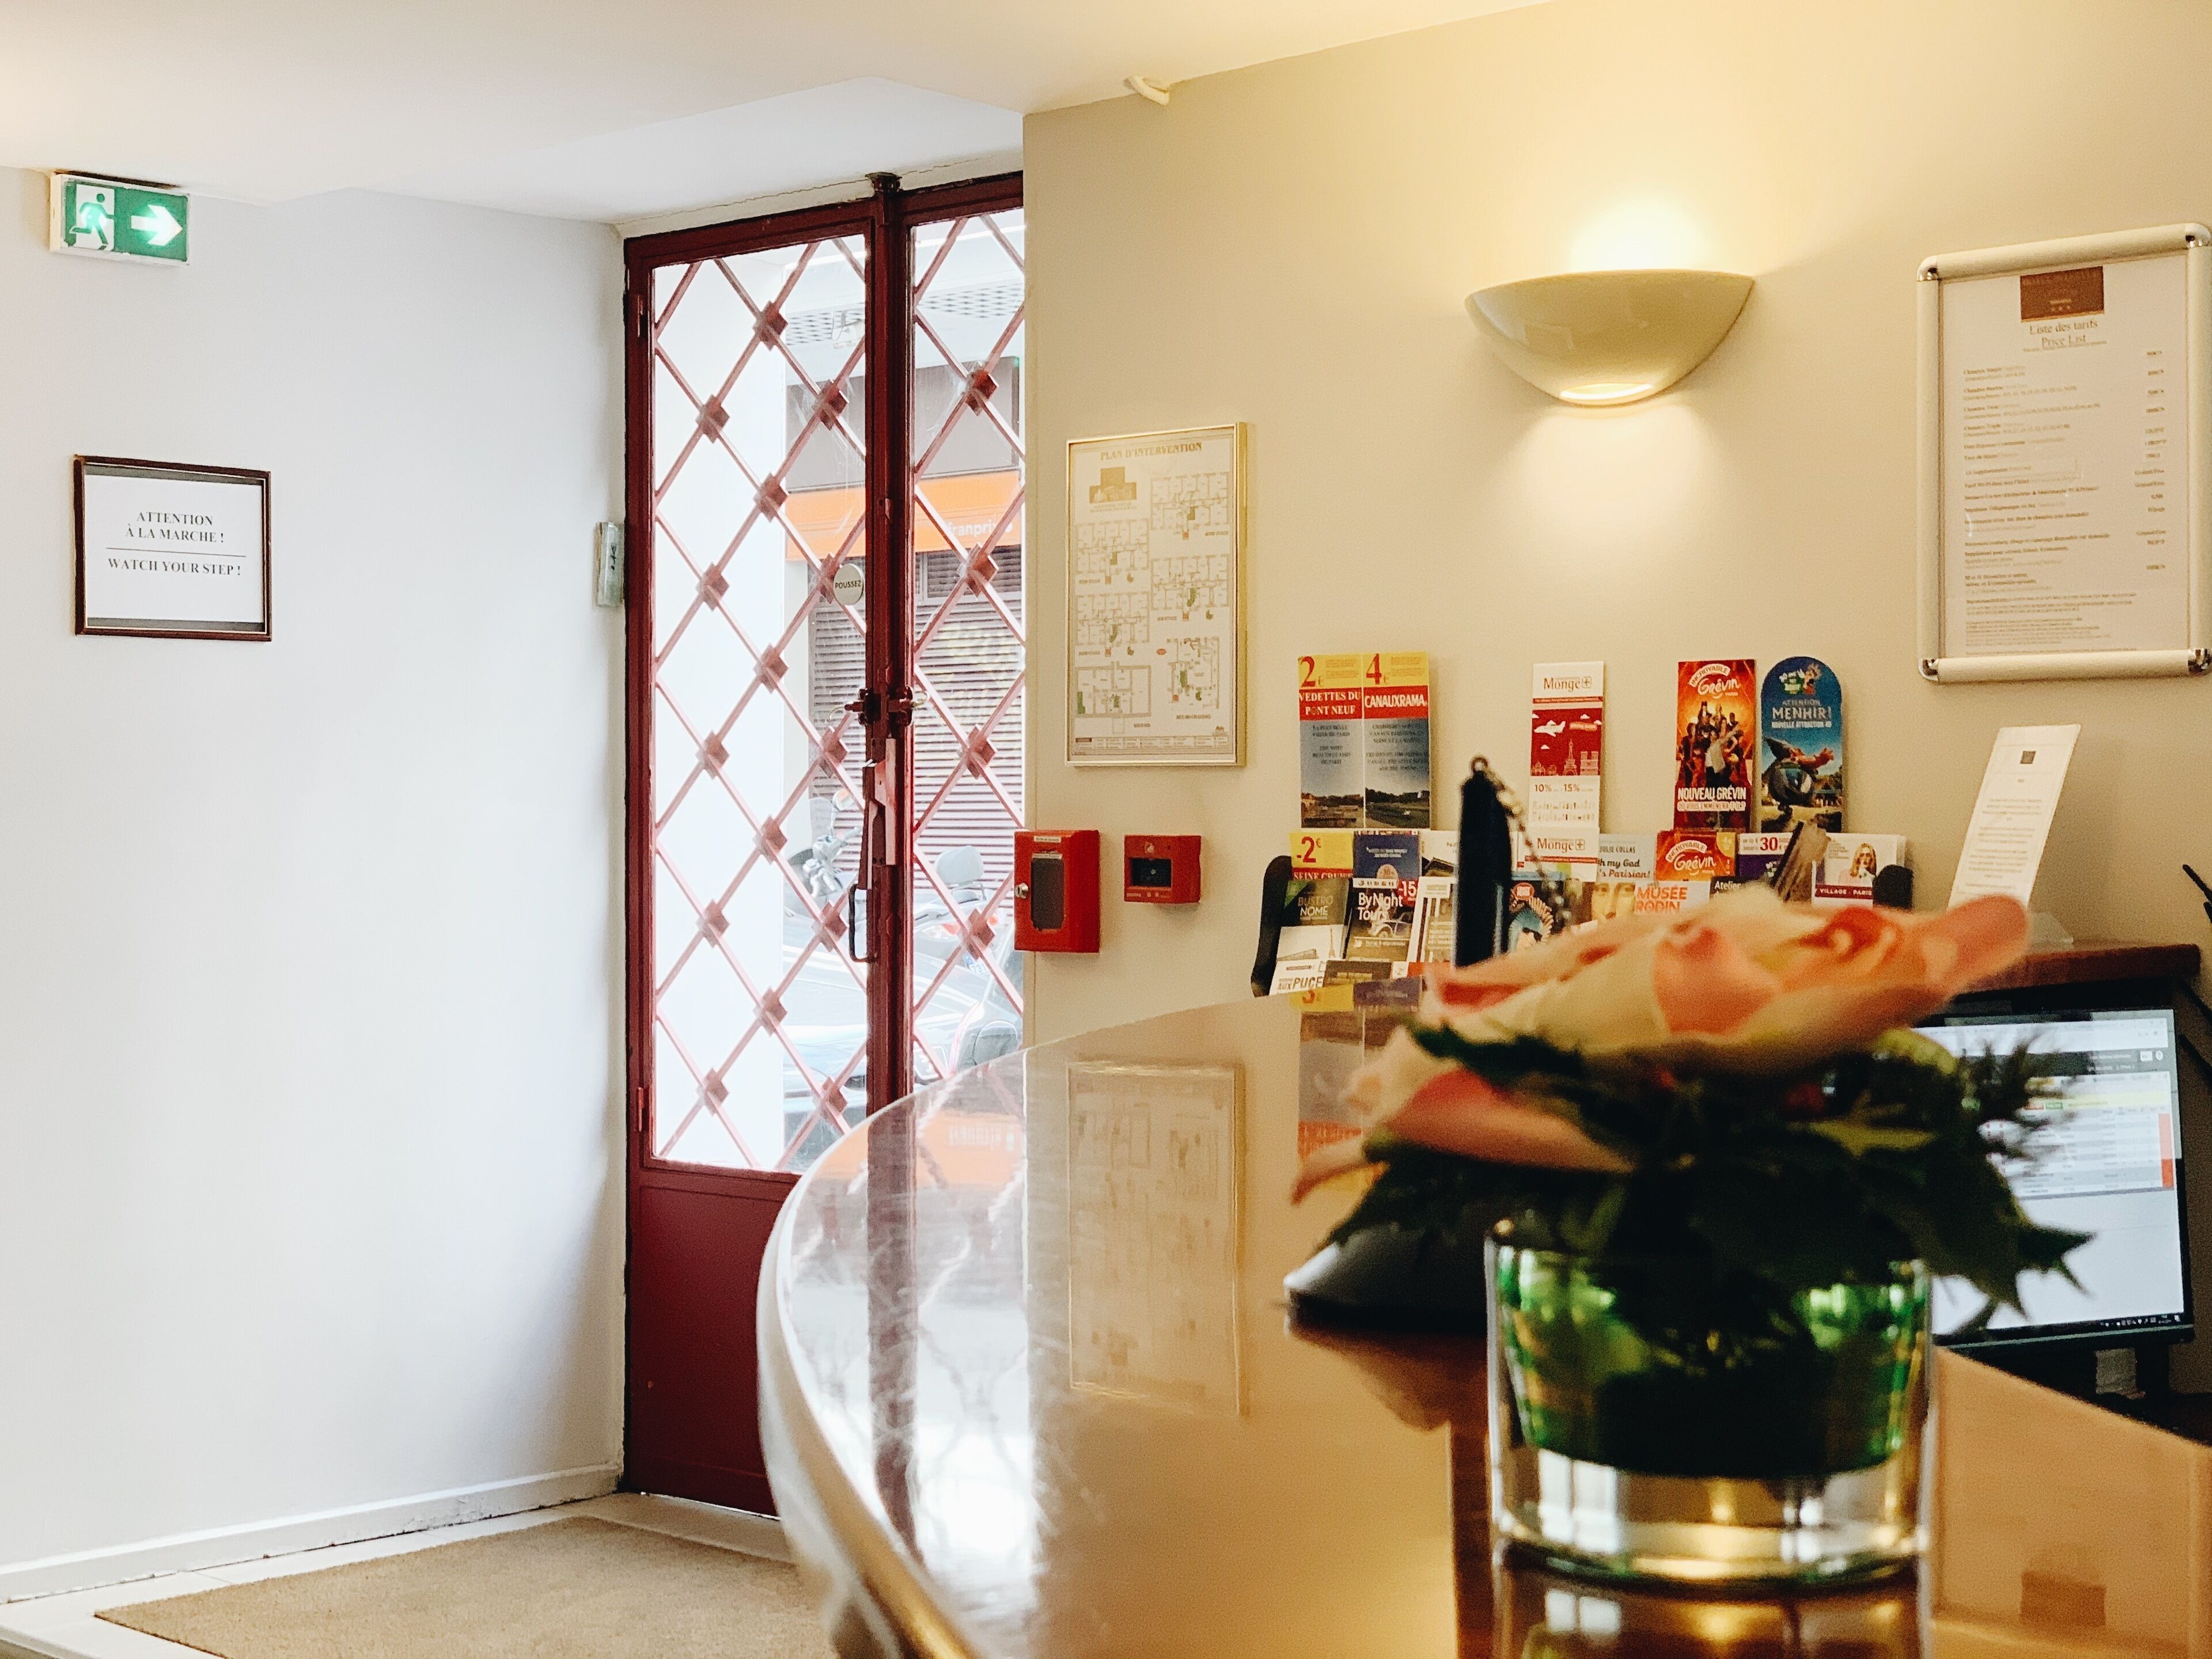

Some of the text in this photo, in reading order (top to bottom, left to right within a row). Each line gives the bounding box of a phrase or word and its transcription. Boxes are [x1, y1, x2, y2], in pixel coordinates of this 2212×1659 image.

[2055, 322, 2071, 332] des
[1101, 442, 1203, 461] PLAN D'INTERVENTION
[137, 511, 213, 527] ATTENTION
[125, 523, 134, 537] À
[138, 528, 155, 539] LA
[160, 529, 217, 543] MARCHE
[108, 558, 158, 571] WATCH
[162, 561, 199, 573] YOUR
[202, 563, 234, 575] STEP
[835, 579, 862, 589] POUSSEZ
[1543, 677, 1581, 692] Monge
[1698, 678, 1741, 696] Grévin
[1299, 691, 1361, 702] VEDETTES DU
[1331, 704, 1356, 714] NEUF
[1535, 783, 1581, 792] 10% 15%
[1677, 787, 1715, 800] NOUVEAU
[1537, 838, 1574, 853] Monge
[1668, 840, 1706, 861] INCROYABLE
[1760, 836, 1778, 851] 30
[1623, 858, 1640, 868] God
[1674, 853, 1716, 872] Grévin
[1608, 869, 1650, 878] Parisian!
[1637, 885, 1688, 900] MUSÉE
[1714, 880, 1741, 891] Atelier
[1300, 906, 1328, 916] NOME
